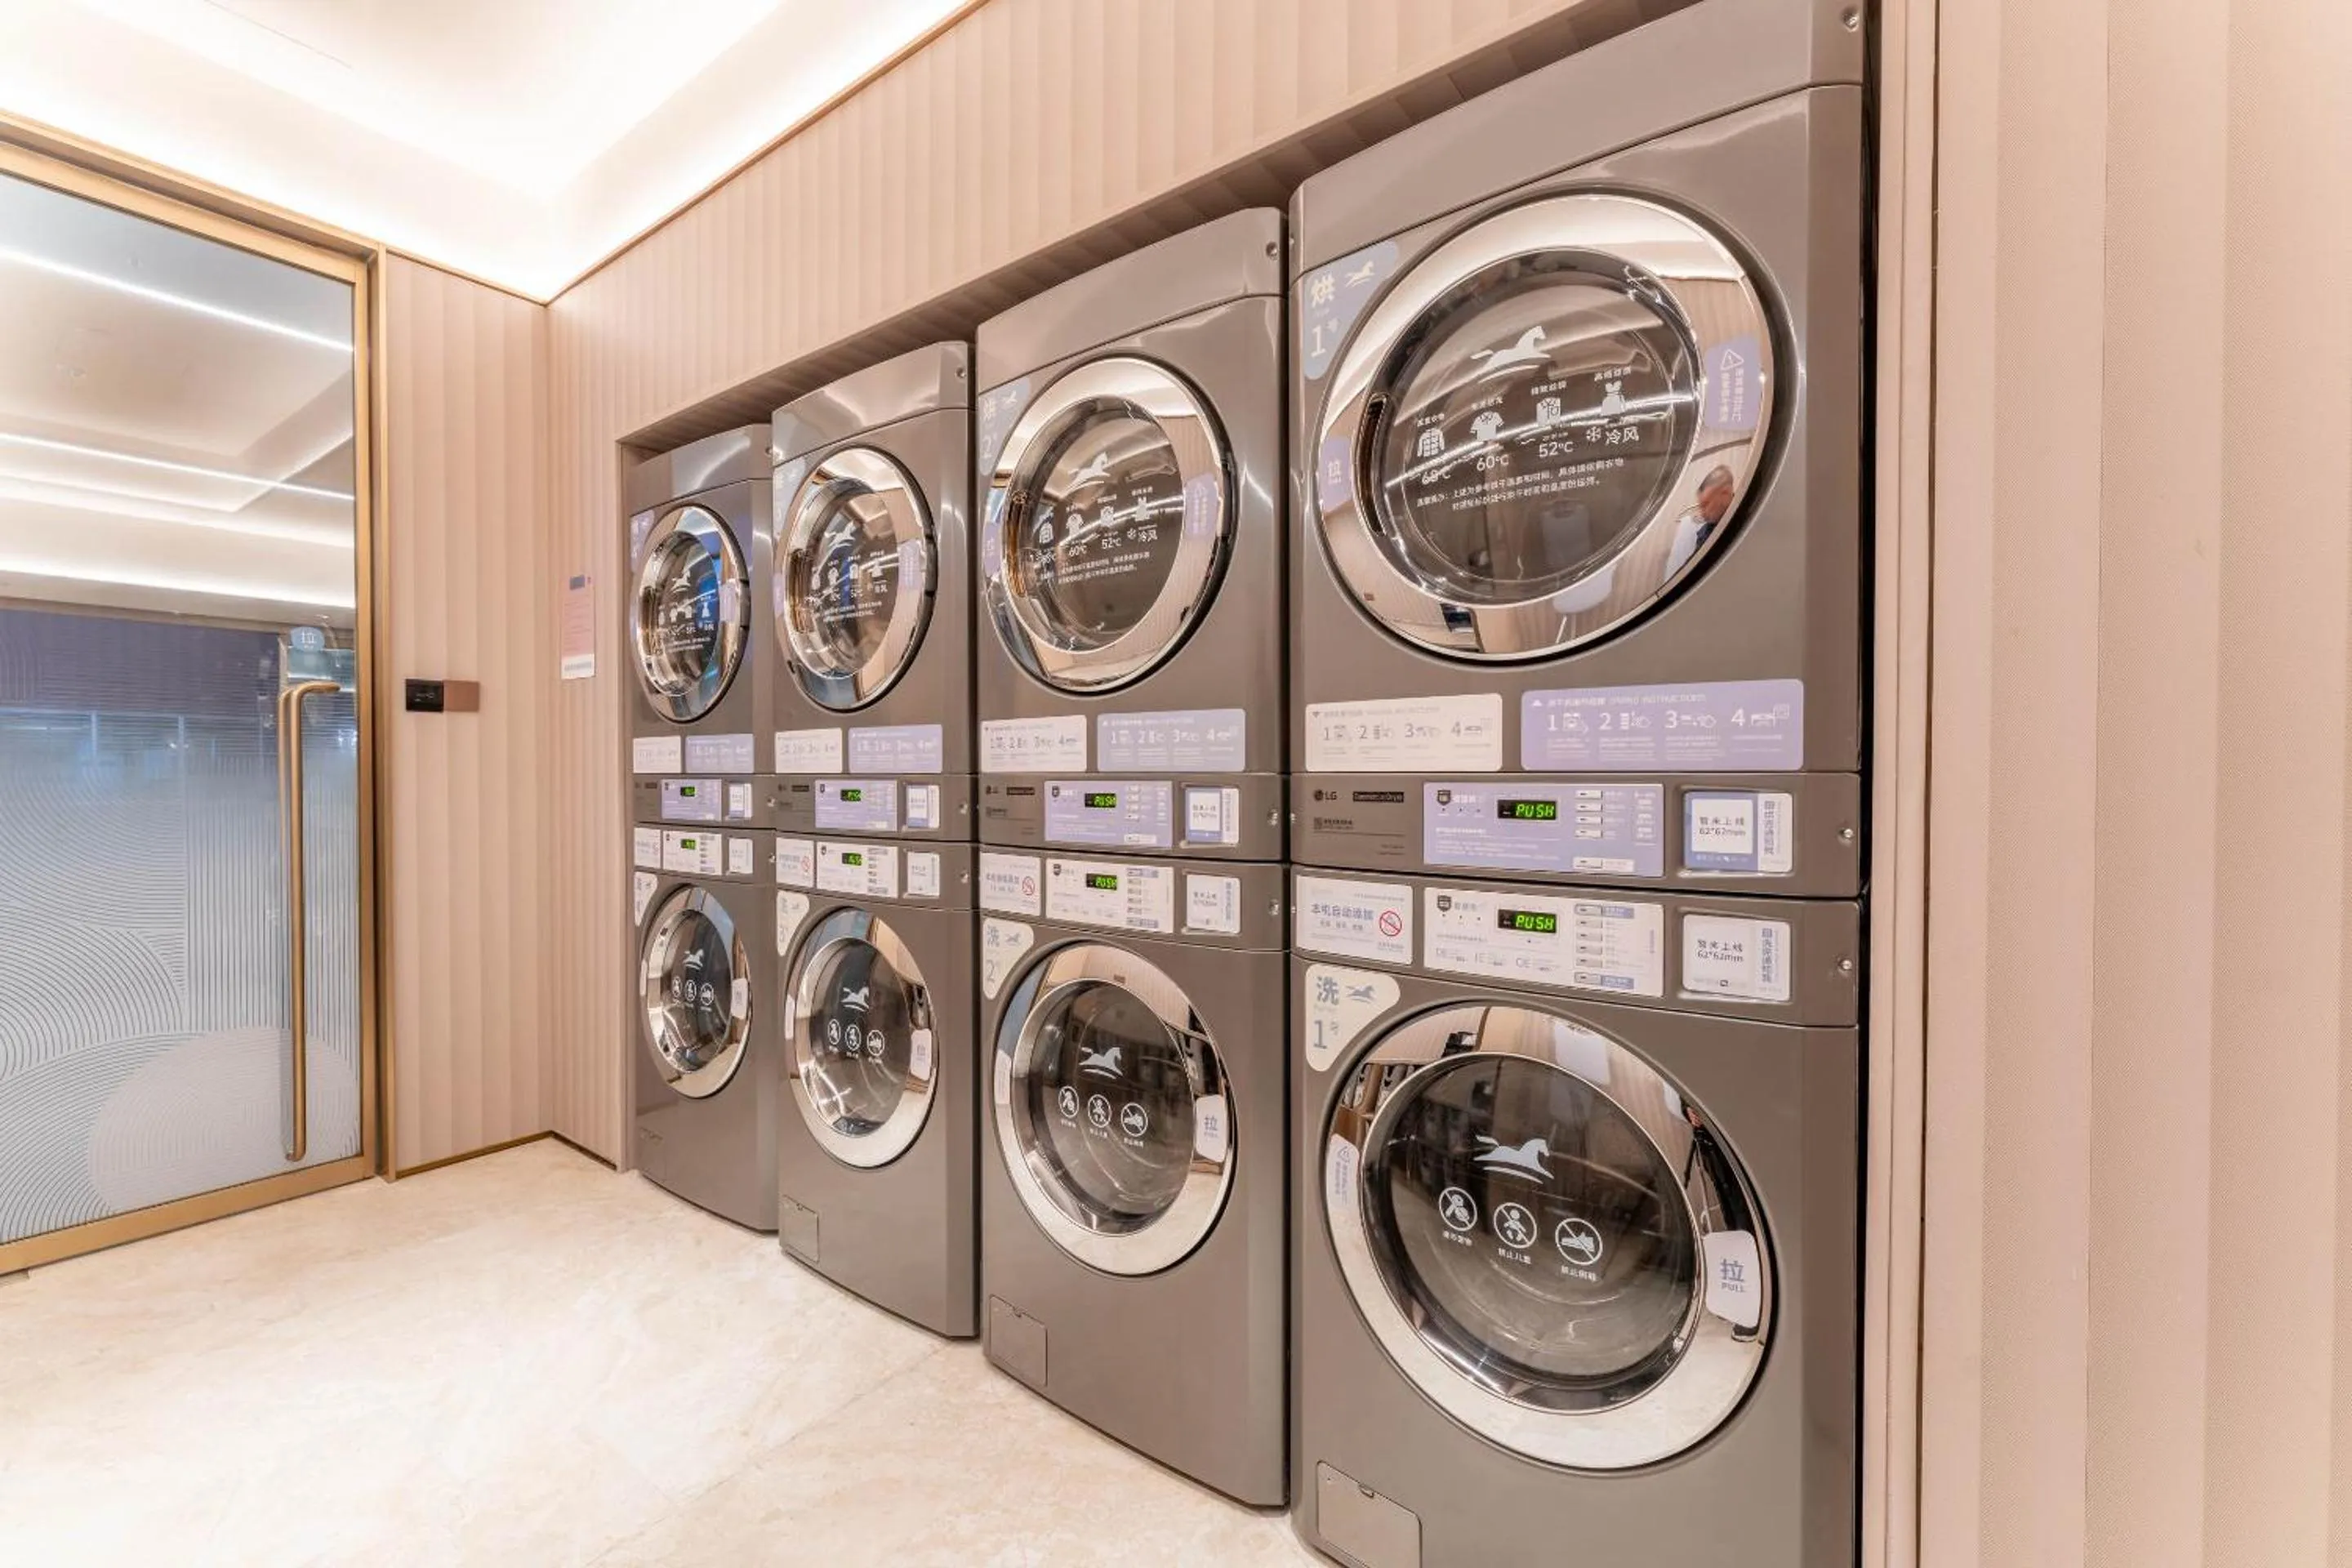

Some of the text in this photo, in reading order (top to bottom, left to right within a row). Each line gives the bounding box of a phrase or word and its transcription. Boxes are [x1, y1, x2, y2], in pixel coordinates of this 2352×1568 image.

[1605, 426, 1641, 444] 冷风
[1516, 804, 1554, 817] PUSH
[1516, 915, 1554, 930] PUSH
[1316, 977, 1339, 1005] 洗
[1720, 1258, 1744, 1282] 拉
[1722, 1282, 1745, 1292] PULL
